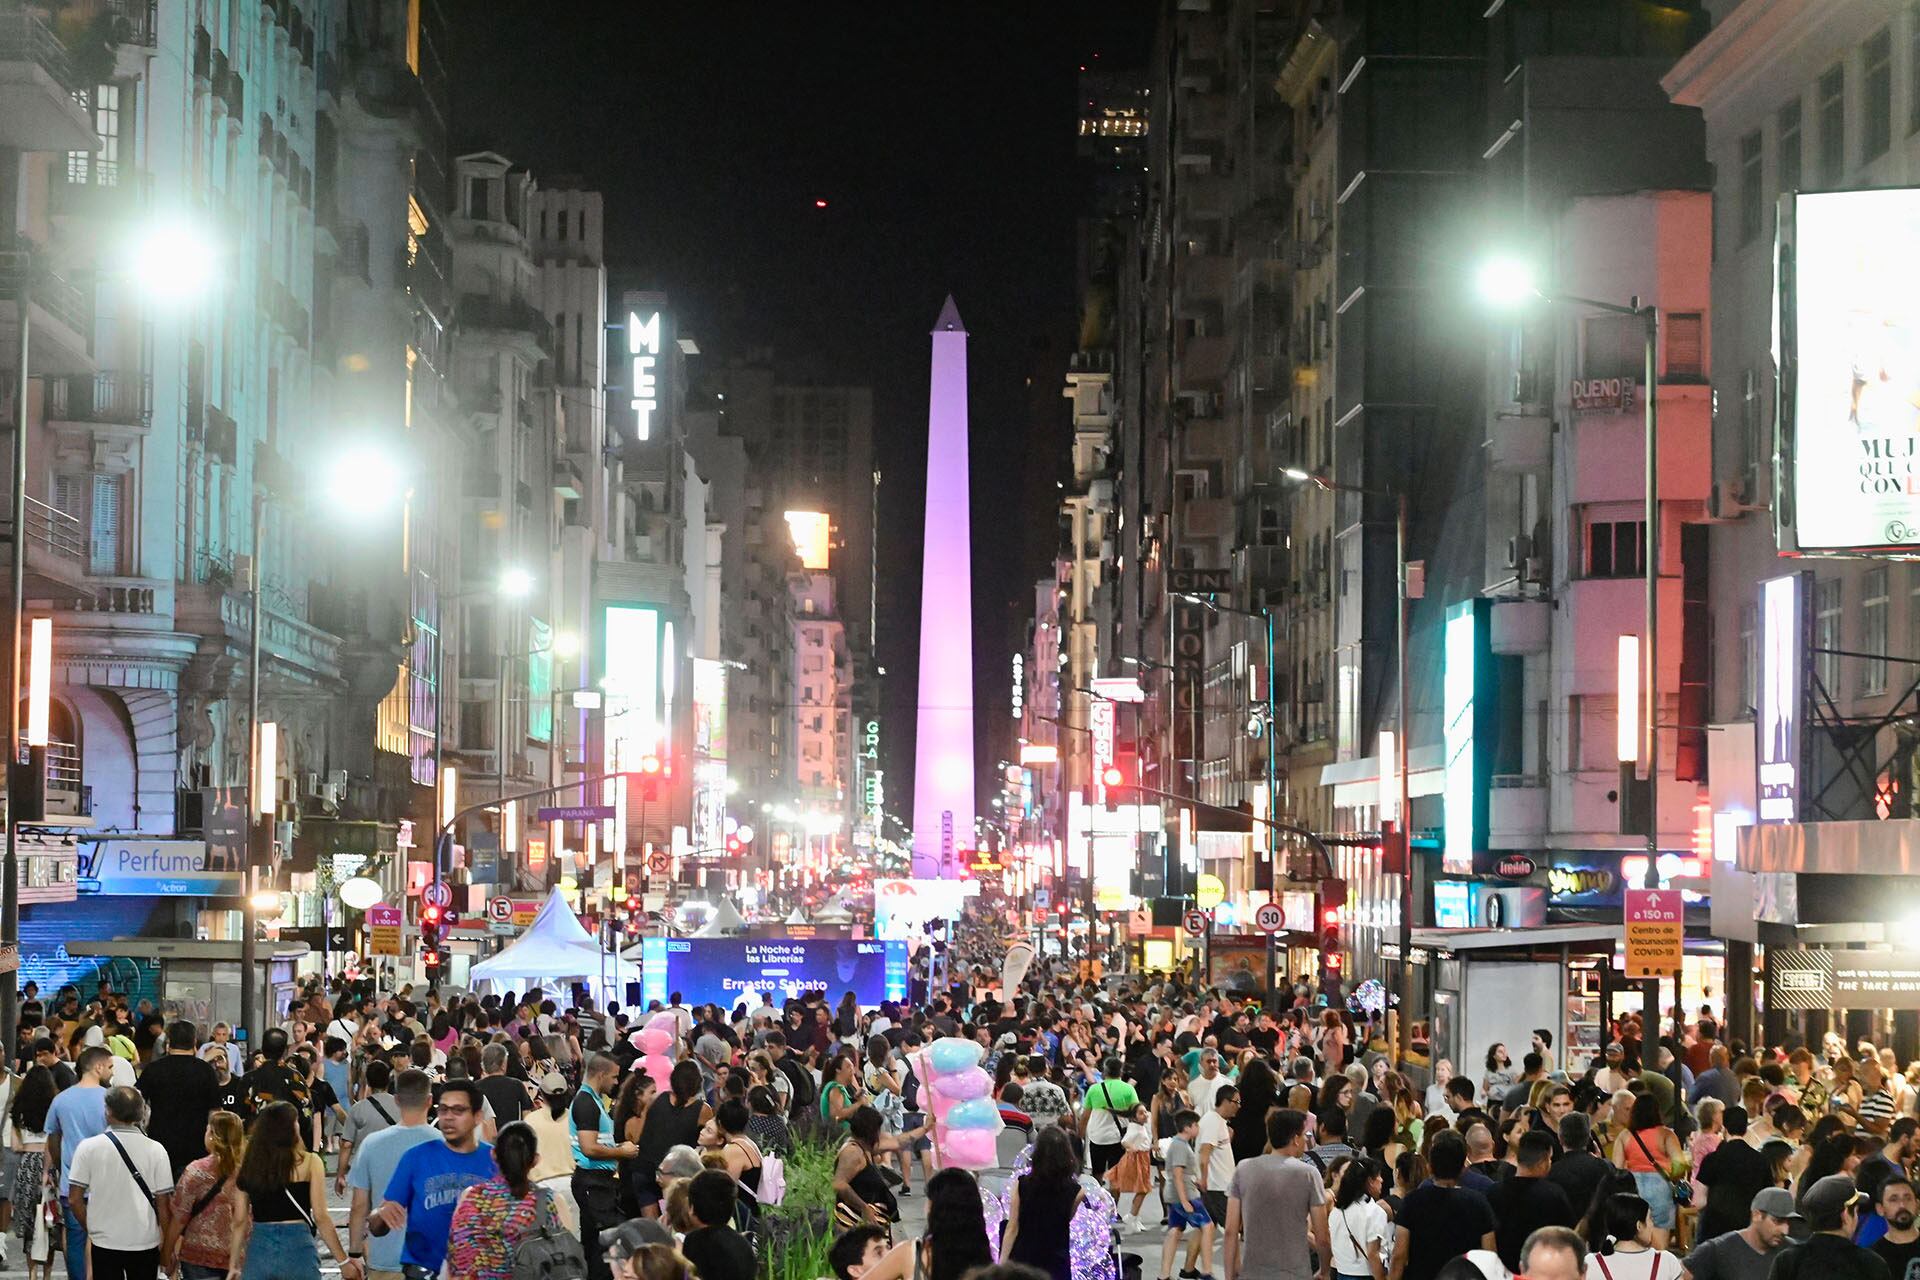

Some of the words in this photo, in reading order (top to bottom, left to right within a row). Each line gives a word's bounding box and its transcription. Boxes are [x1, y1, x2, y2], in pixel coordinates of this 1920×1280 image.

[630, 311, 659, 441] MET
[118, 849, 204, 872] Perfume
[1262, 911, 1280, 924] 30
[1634, 911, 1641, 919] a
[1643, 910, 1662, 919] 150
[1663, 911, 1675, 919] m
[1632, 926, 1661, 934] Centro
[1663, 926, 1674, 934] de
[745, 945, 757, 954] La
[760, 945, 790, 954] Noche
[793, 945, 805, 954] de
[747, 954, 760, 963] las
[1837, 981, 1858, 990] THE
[1862, 981, 1889, 991] TAKE
